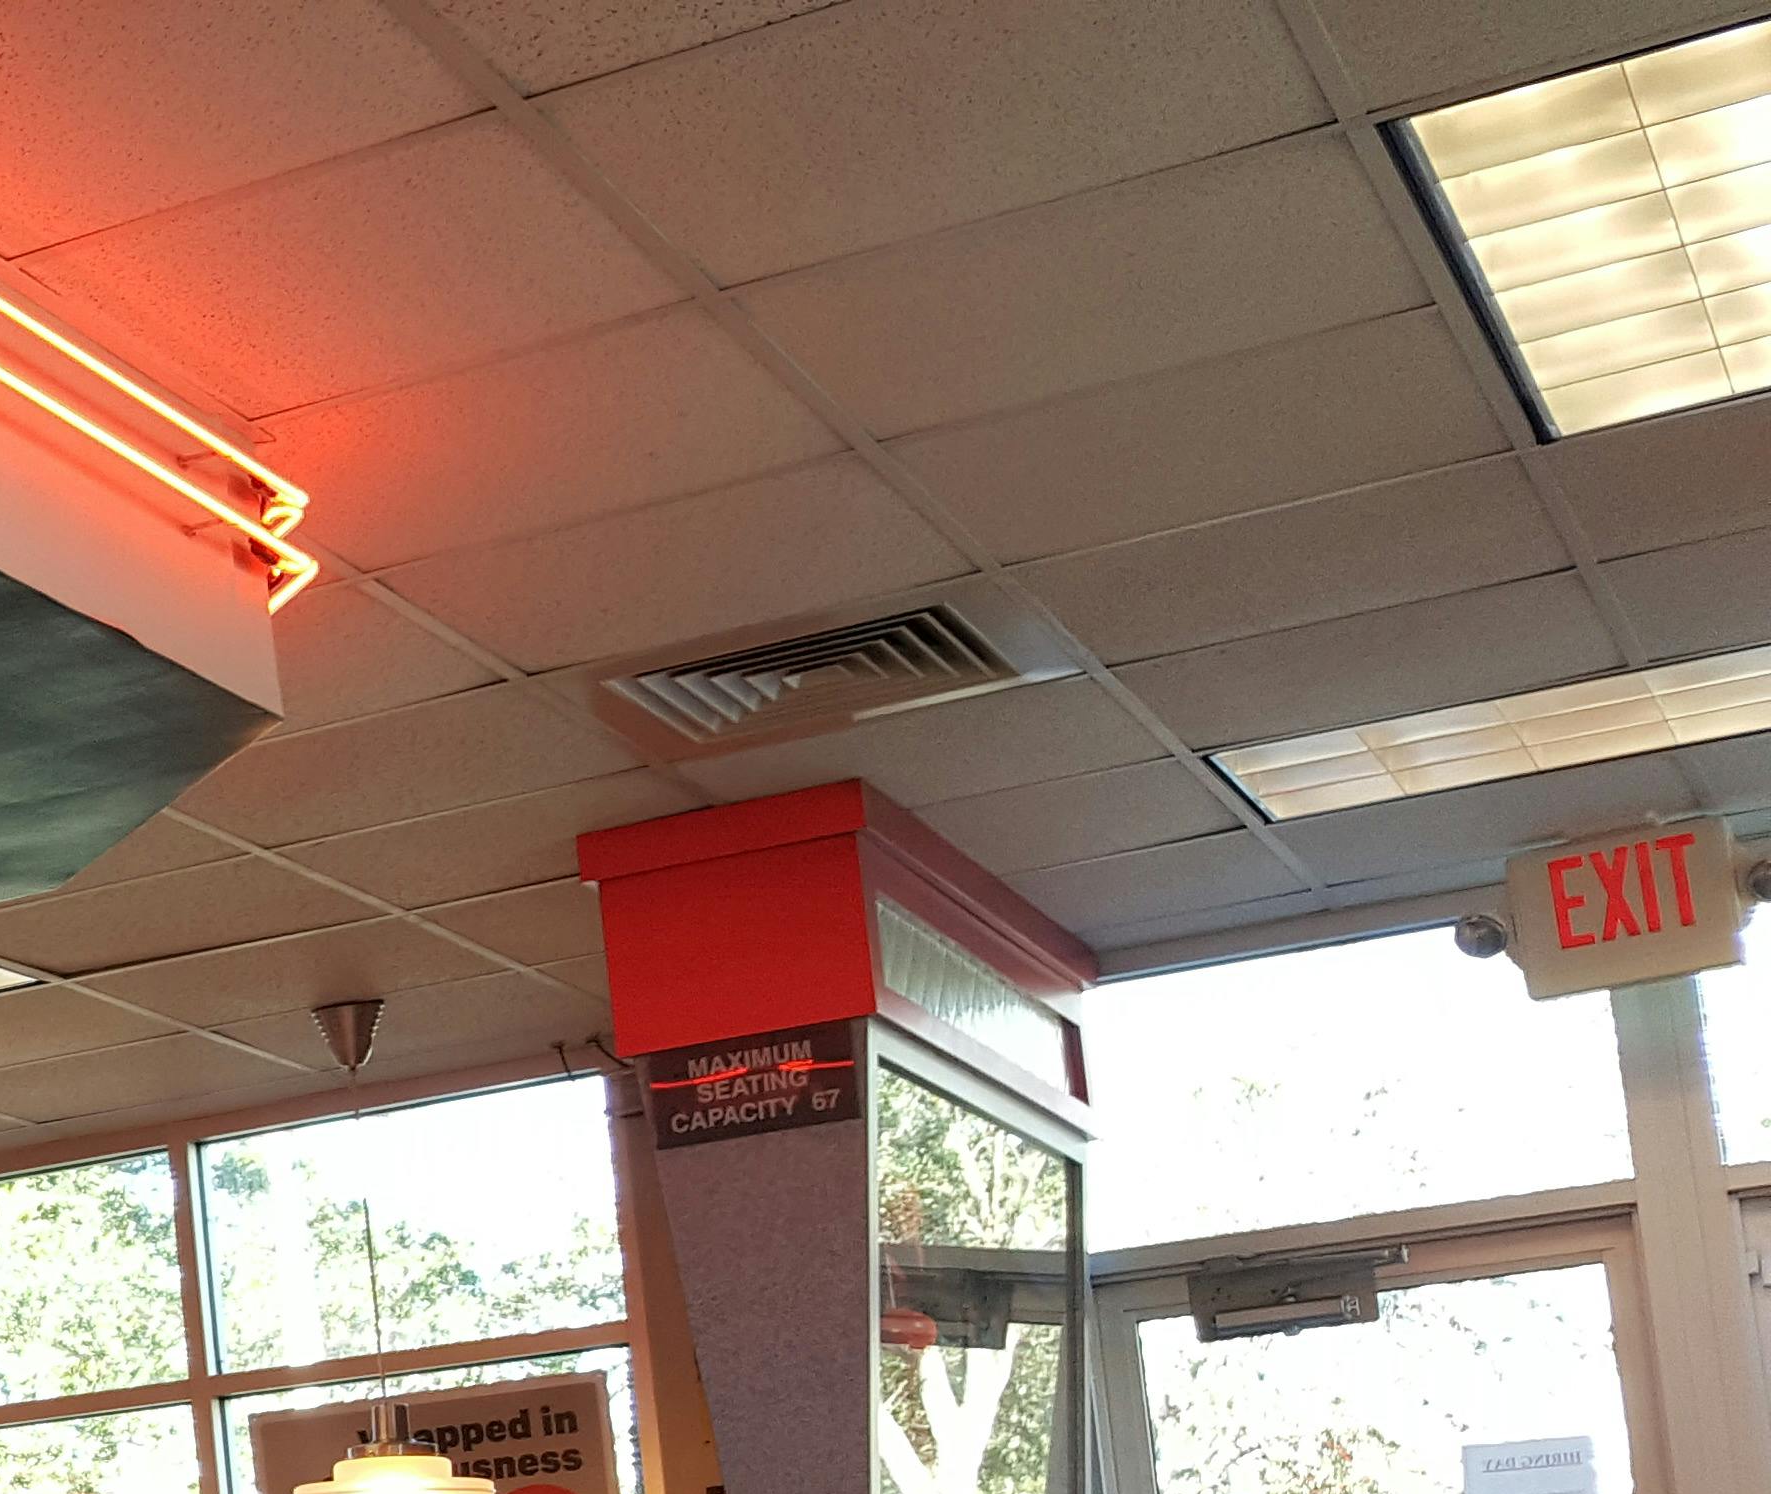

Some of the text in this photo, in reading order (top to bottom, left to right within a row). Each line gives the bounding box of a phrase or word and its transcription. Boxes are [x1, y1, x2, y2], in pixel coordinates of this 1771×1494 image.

[1546, 832, 1695, 951] EXIT
[687, 1039, 813, 1080] MAXIMUM
[696, 1069, 809, 1105] SEATING
[670, 1088, 841, 1134] CAPACITY 67
[357, 1405, 579, 1454] apped in
